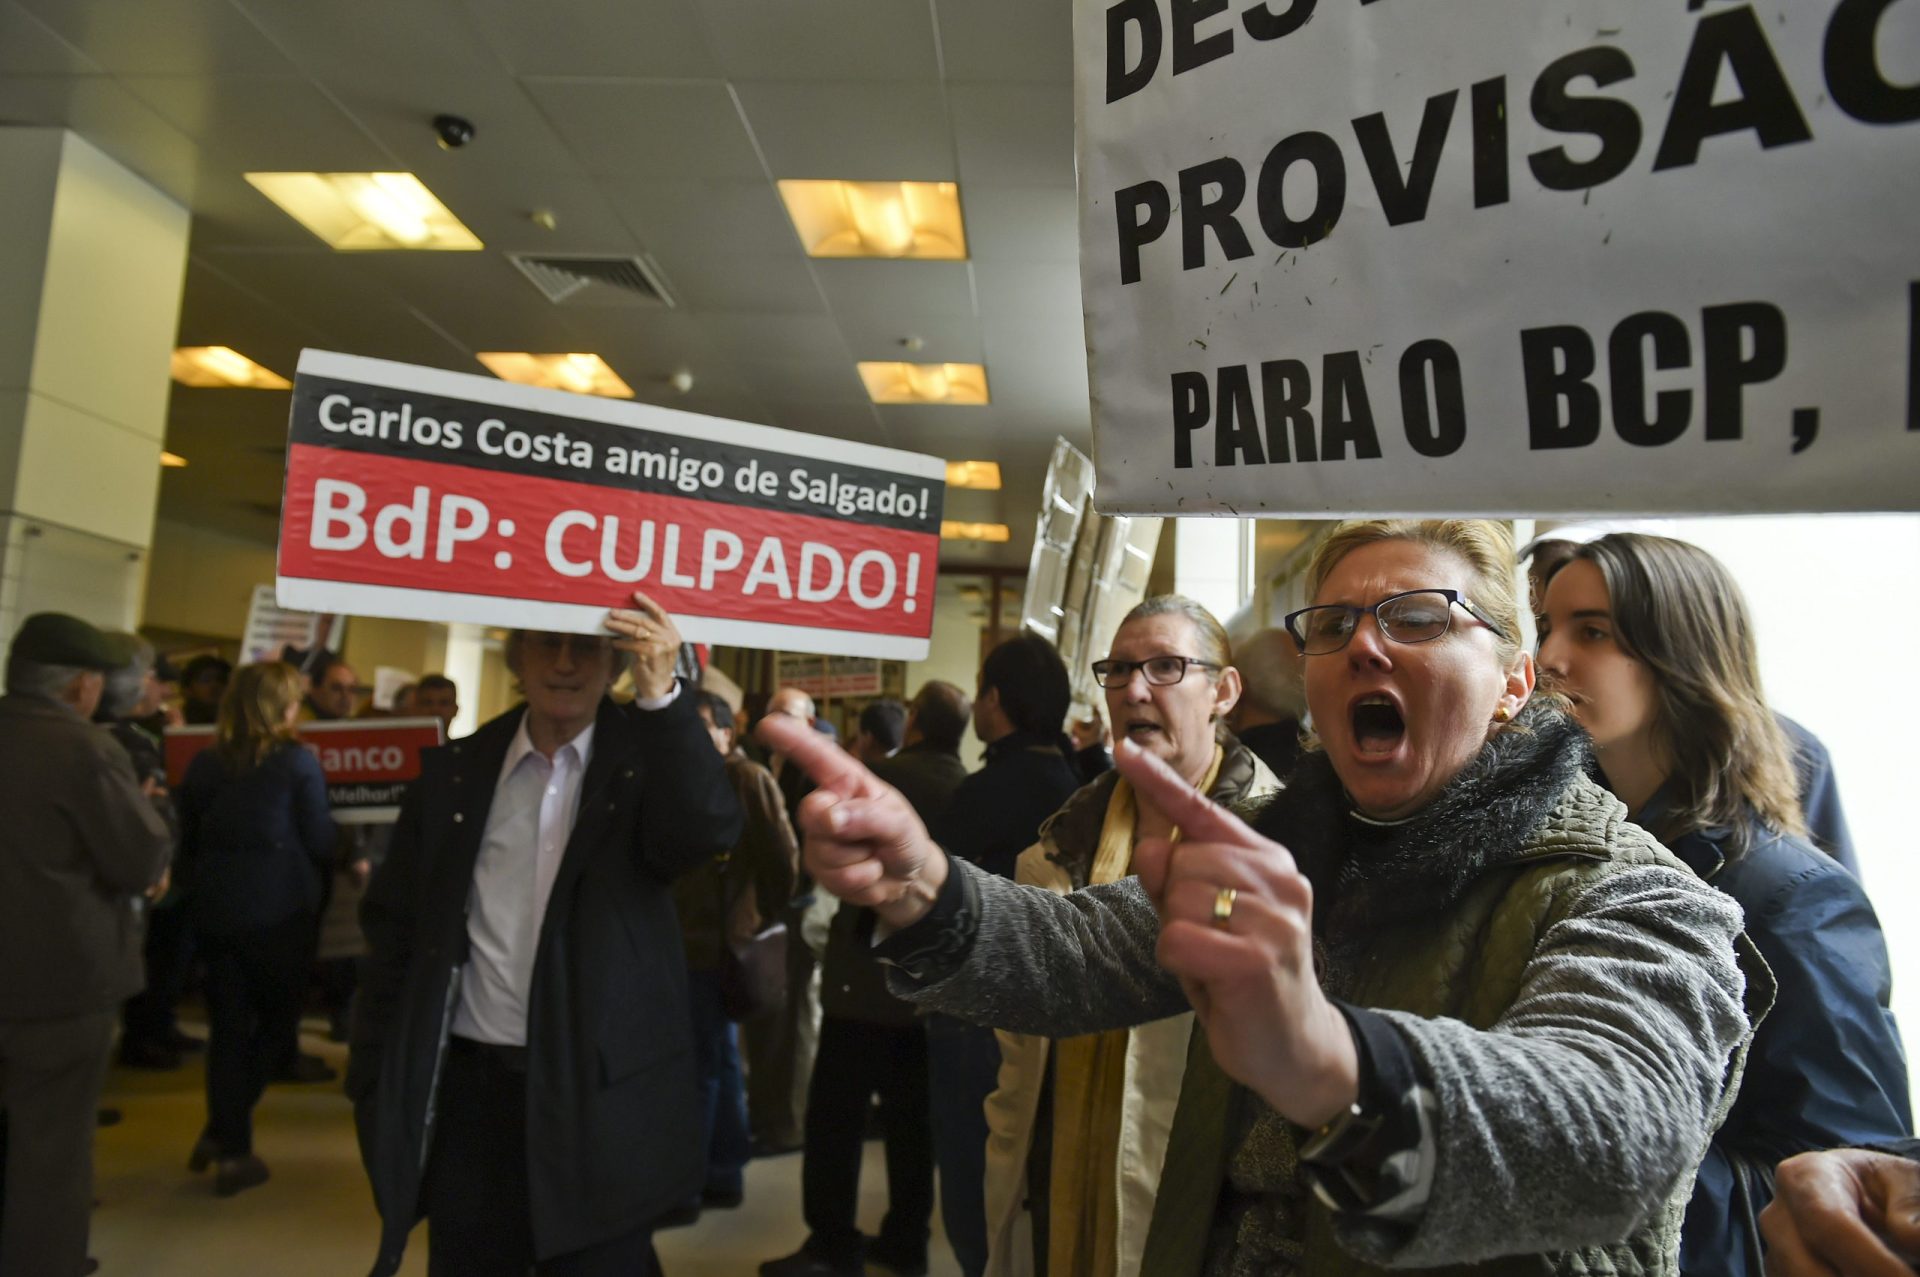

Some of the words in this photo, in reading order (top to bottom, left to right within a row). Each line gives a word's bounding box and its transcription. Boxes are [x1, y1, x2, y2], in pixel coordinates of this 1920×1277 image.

[1106, 0, 1381, 104] DE
[1171, 350, 1382, 469] PARA
[1399, 338, 1467, 457] O
[1520, 301, 1820, 455] BCP,
[318, 394, 463, 449] Carlos
[476, 419, 593, 469] Costa
[605, 446, 724, 493] amigo
[734, 459, 779, 497] de
[787, 468, 929, 520] Salgado!
[309, 478, 516, 569] BdP:
[545, 509, 920, 613] CULPADO!
